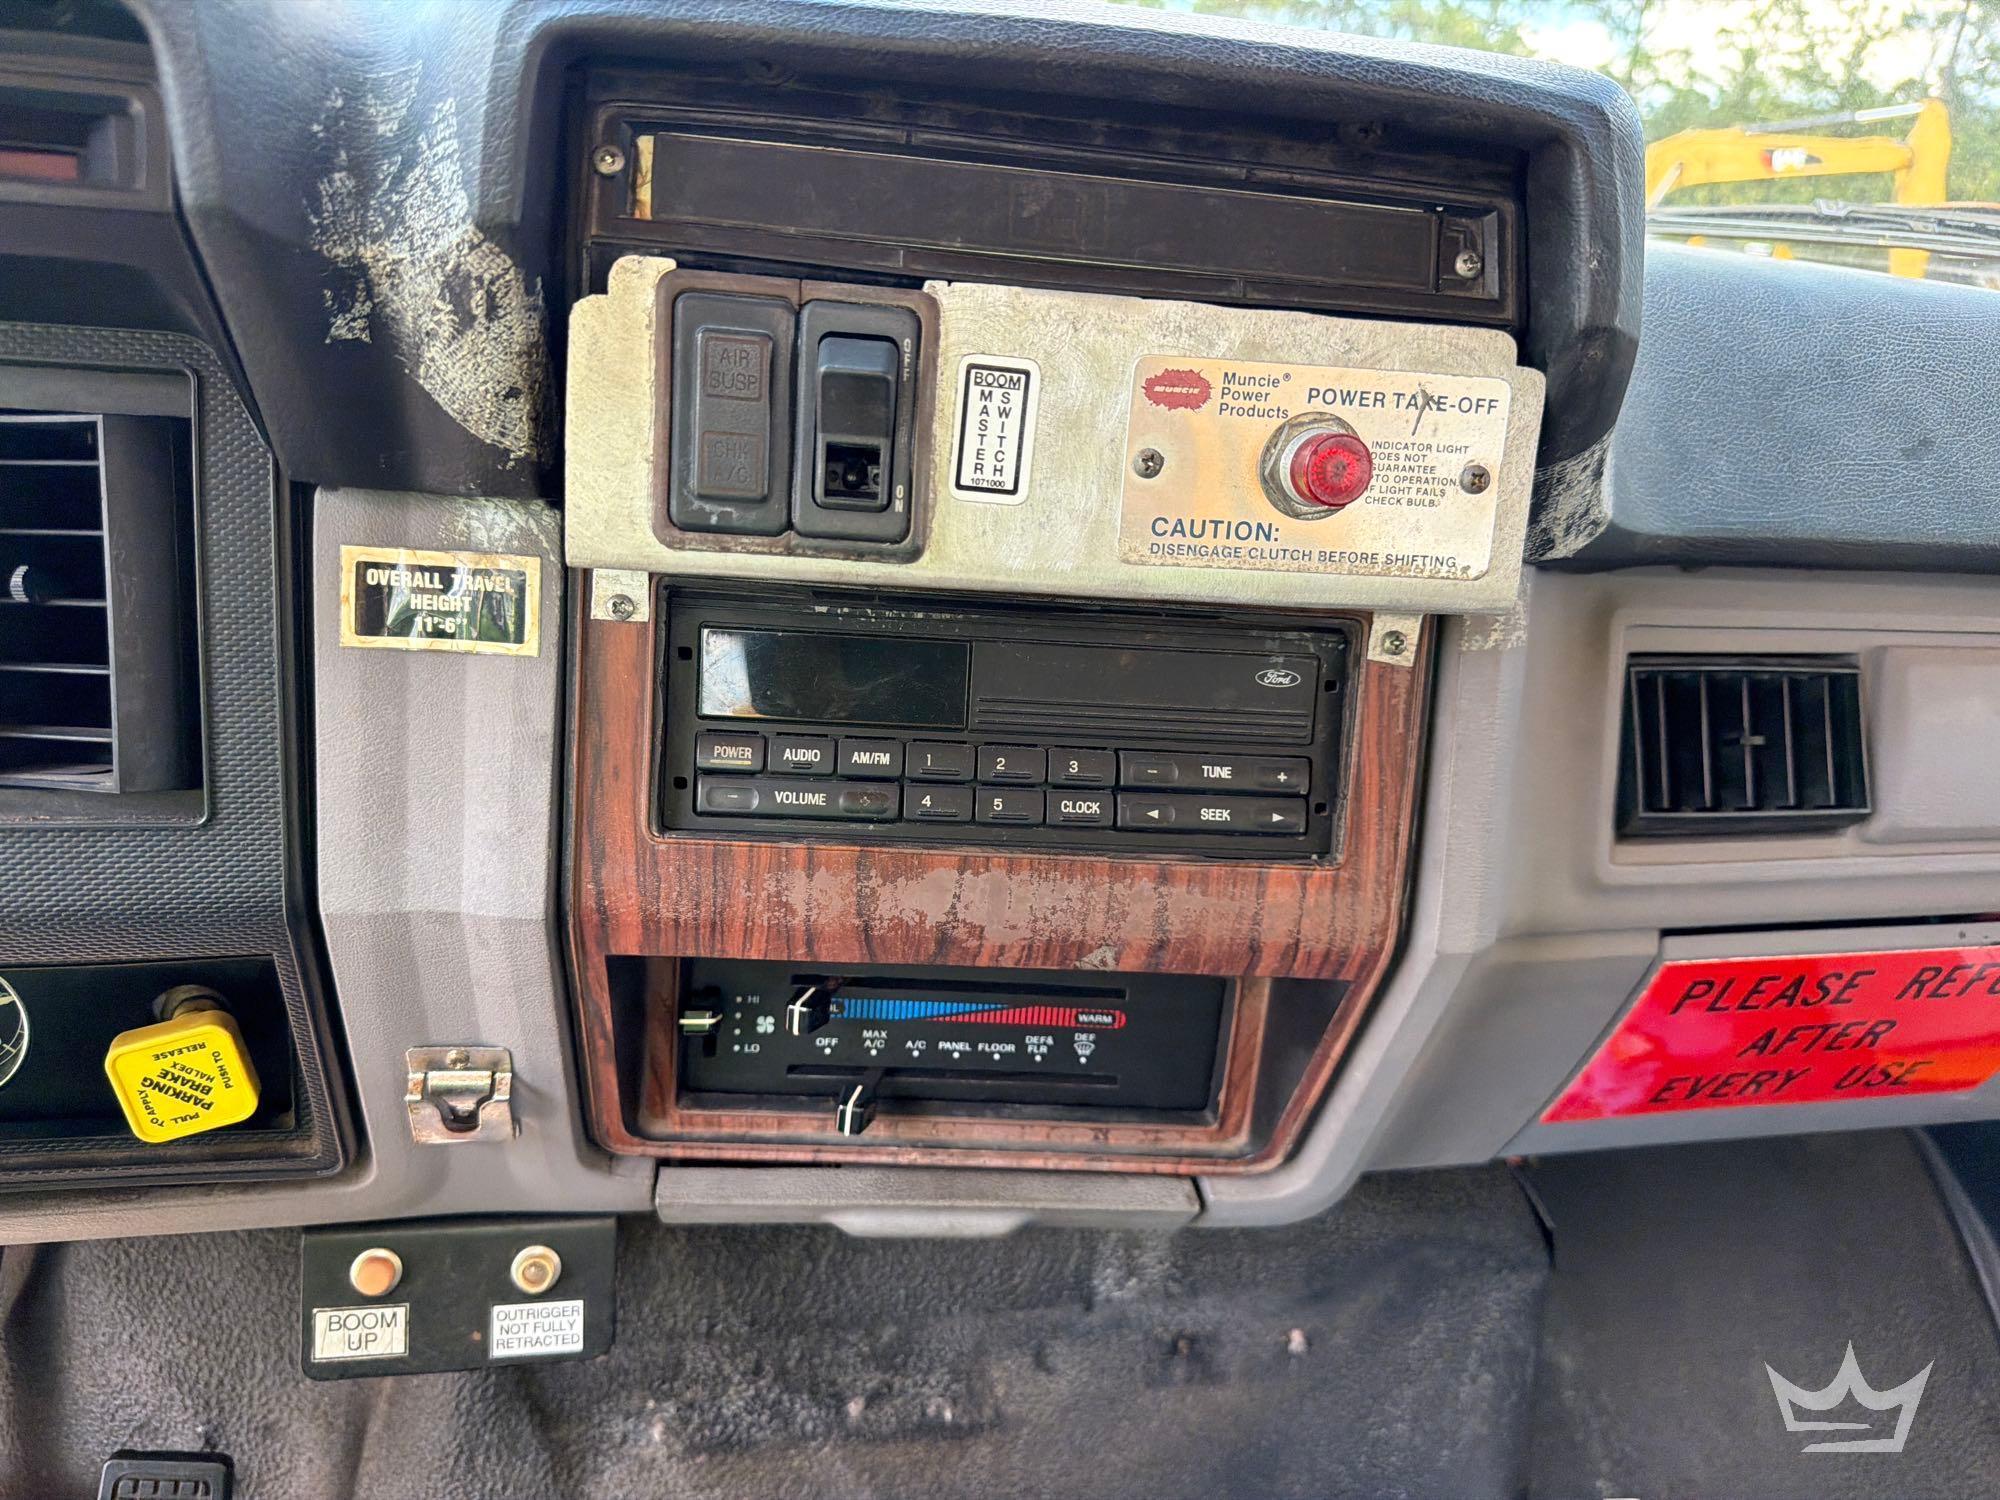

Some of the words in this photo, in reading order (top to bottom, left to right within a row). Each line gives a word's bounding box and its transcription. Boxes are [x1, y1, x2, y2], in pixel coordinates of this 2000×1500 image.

[719, 347, 750, 366] AIR
[902, 338, 912, 382] OFF
[709, 370, 758, 391] SUSP
[974, 371, 1022, 391] BOOM
[1153, 385, 1201, 395] MUNCIE
[1220, 387, 1271, 402] Power
[1306, 387, 1386, 409] POWER
[1393, 392, 1499, 415] TAKE-OFF
[1218, 402, 1290, 419] Products
[973, 389, 993, 475] MASTER
[993, 391, 1013, 477] SWITCH
[1371, 440, 1433, 453] INDICATOR
[1436, 444, 1470, 455] LIGHT
[1404, 453, 1428, 463] NOT
[970, 477, 1006, 488] 1071000
[894, 484, 904, 513] ON
[1379, 485, 1413, 496] LIGHT
[1416, 487, 1447, 498] FAILS
[1365, 495, 1403, 506] CHECK
[1151, 516, 1280, 543] CAUTION:
[1149, 542, 1243, 559] DISENGAGE
[1248, 546, 1313, 562] CLUTCH
[1318, 551, 1379, 565] BEFORE
[1384, 554, 1457, 568] SHIFTING
[366, 568, 444, 590] OVERALL
[451, 573, 515, 593] TRAVEL
[410, 593, 473, 612] HEIGHT
[1263, 671, 1293, 685] Ford
[713, 745, 752, 760] POWER
[783, 748, 821, 762] AUDIO
[851, 751, 890, 765] AM/FM
[926, 754, 933, 767] 1
[996, 757, 1006, 771] 2
[1068, 760, 1079, 773] 3
[1201, 765, 1232, 779] TUNE
[774, 791, 827, 806] VOLUME
[921, 795, 932, 808] 4
[993, 798, 1003, 811] 5
[1060, 800, 1100, 815] CLOCK
[1200, 807, 1231, 822] SEEK
[747, 994, 760, 1004] HI
[1669, 969, 1876, 1016] PLEASE
[1077, 1012, 1113, 1025] WARM
[862, 1029, 888, 1040] MAX
[1074, 1032, 1096, 1043] DEF
[1737, 1019, 1897, 1058] AFTER
[744, 1043, 761, 1054] LO
[815, 1037, 839, 1048] OFF
[863, 1039, 886, 1050] A/C
[905, 1039, 927, 1050] A/C
[938, 1041, 972, 1052] PANEL
[978, 1043, 1016, 1054] FLOOR
[1028, 1044, 1048, 1055] FLR
[152, 1042, 207, 1061] RELEASE
[212, 1050, 223, 1064] TO
[171, 1061, 216, 1083] HALDEX
[218, 1065, 234, 1090] PUSH
[157, 1068, 214, 1096] BRAKE
[1649, 1067, 1812, 1104] EVERY
[1832, 1060, 1936, 1091] USE
[140, 1076, 215, 1111] PARKING
[137, 1089, 157, 1117] APPLY
[150, 1117, 165, 1128] TO
[170, 1111, 200, 1125] PULL
[496, 1305, 581, 1322] OUTRIGGER
[328, 1311, 398, 1332] BOOM
[500, 1323, 530, 1335] NOT
[534, 1319, 577, 1333] FULLY
[348, 1333, 378, 1351] UP
[496, 1333, 581, 1350] RETRACTED
